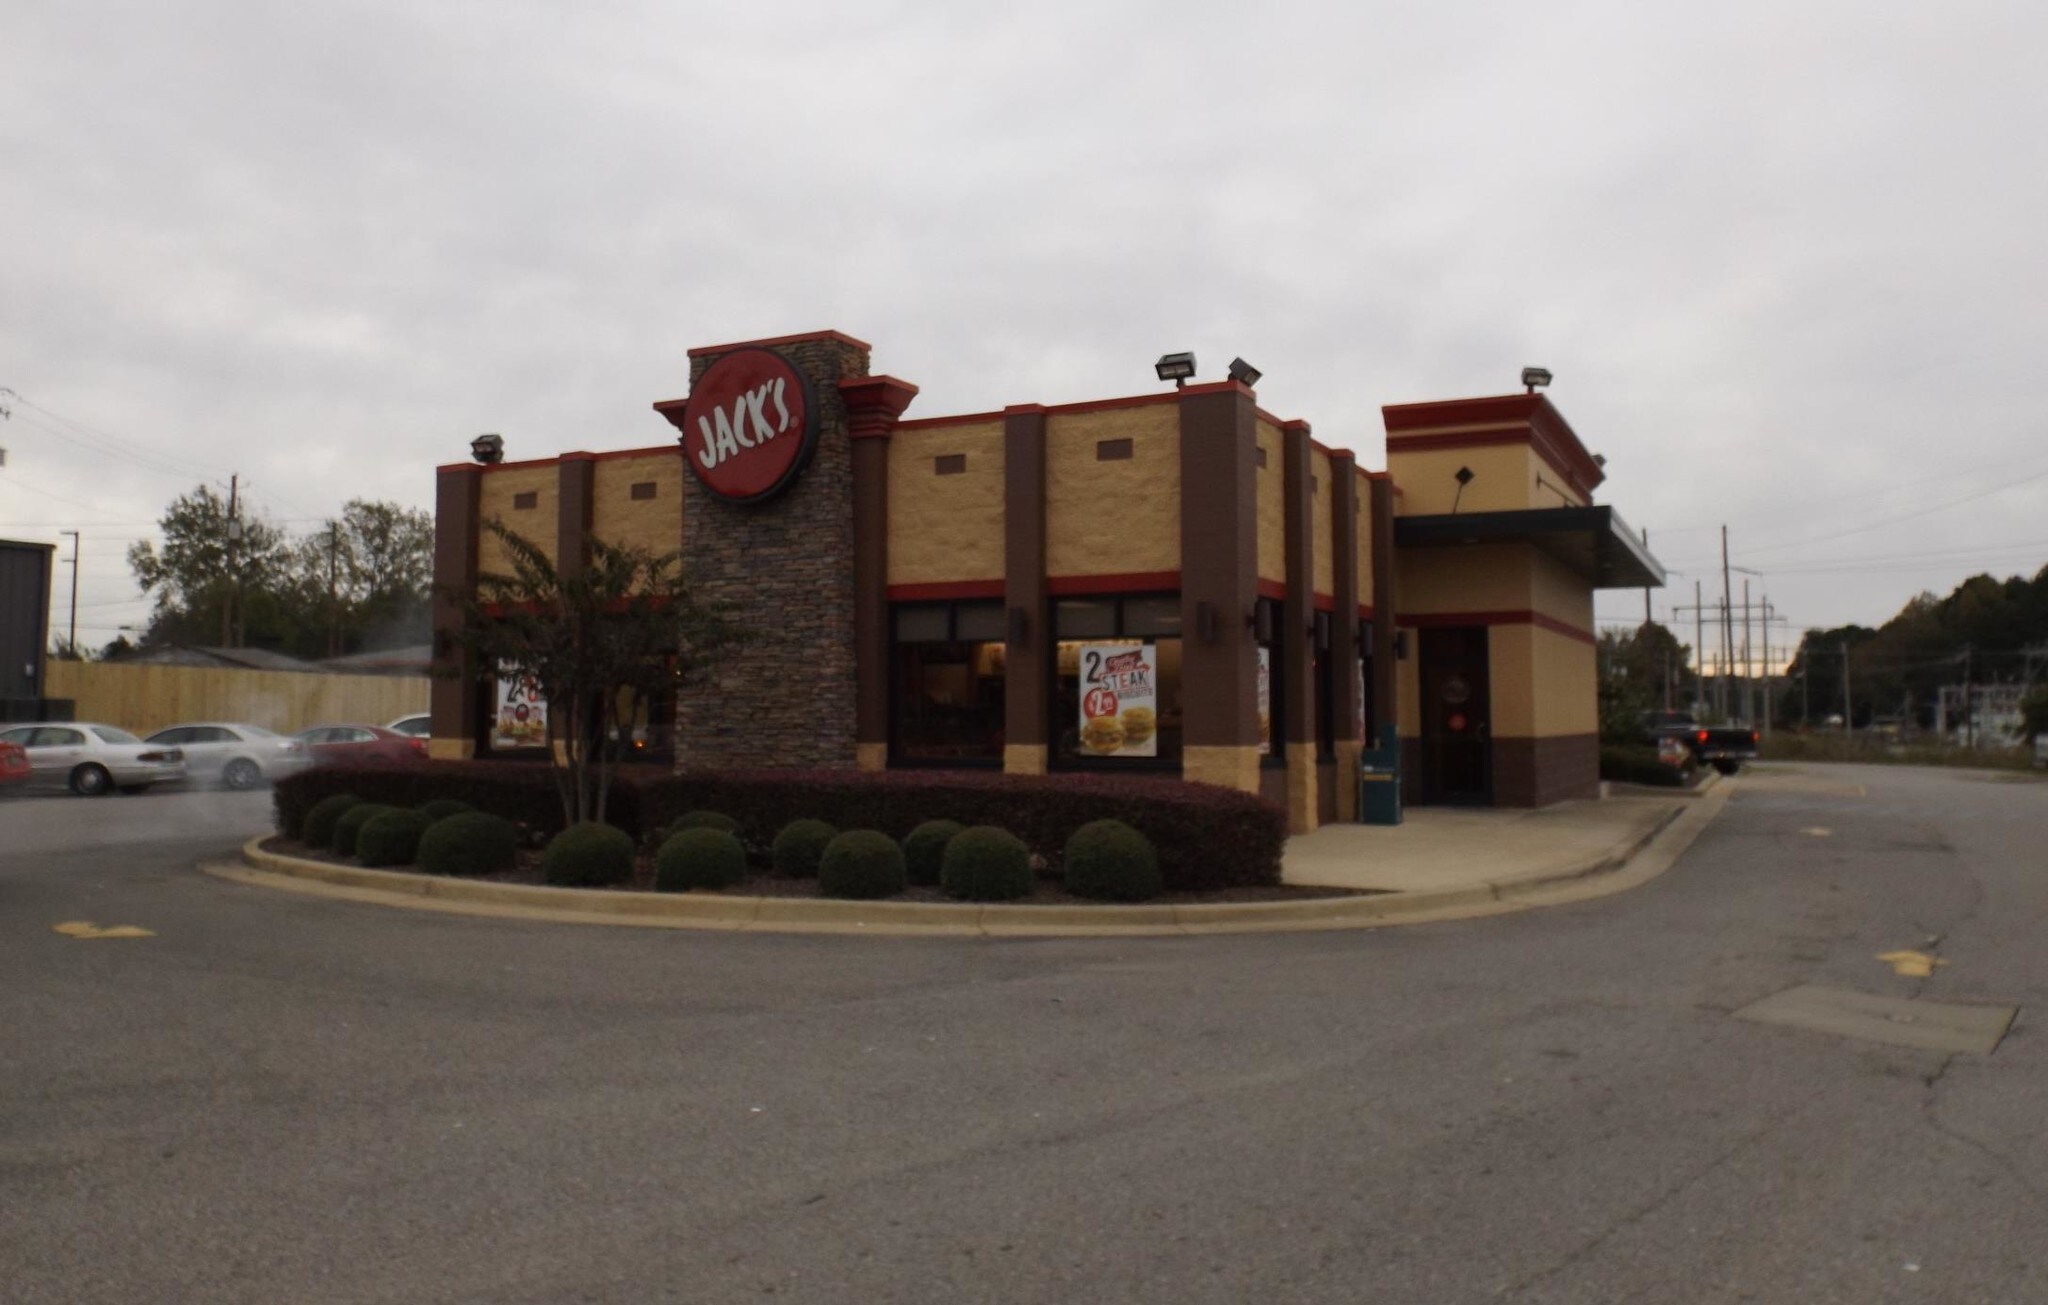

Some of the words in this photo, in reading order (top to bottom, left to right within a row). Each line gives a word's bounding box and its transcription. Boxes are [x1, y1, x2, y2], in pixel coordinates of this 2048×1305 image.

[698, 377, 789, 469] JACK'S
[1086, 651, 1101, 683] 2
[1101, 671, 1146, 690] STEAK
